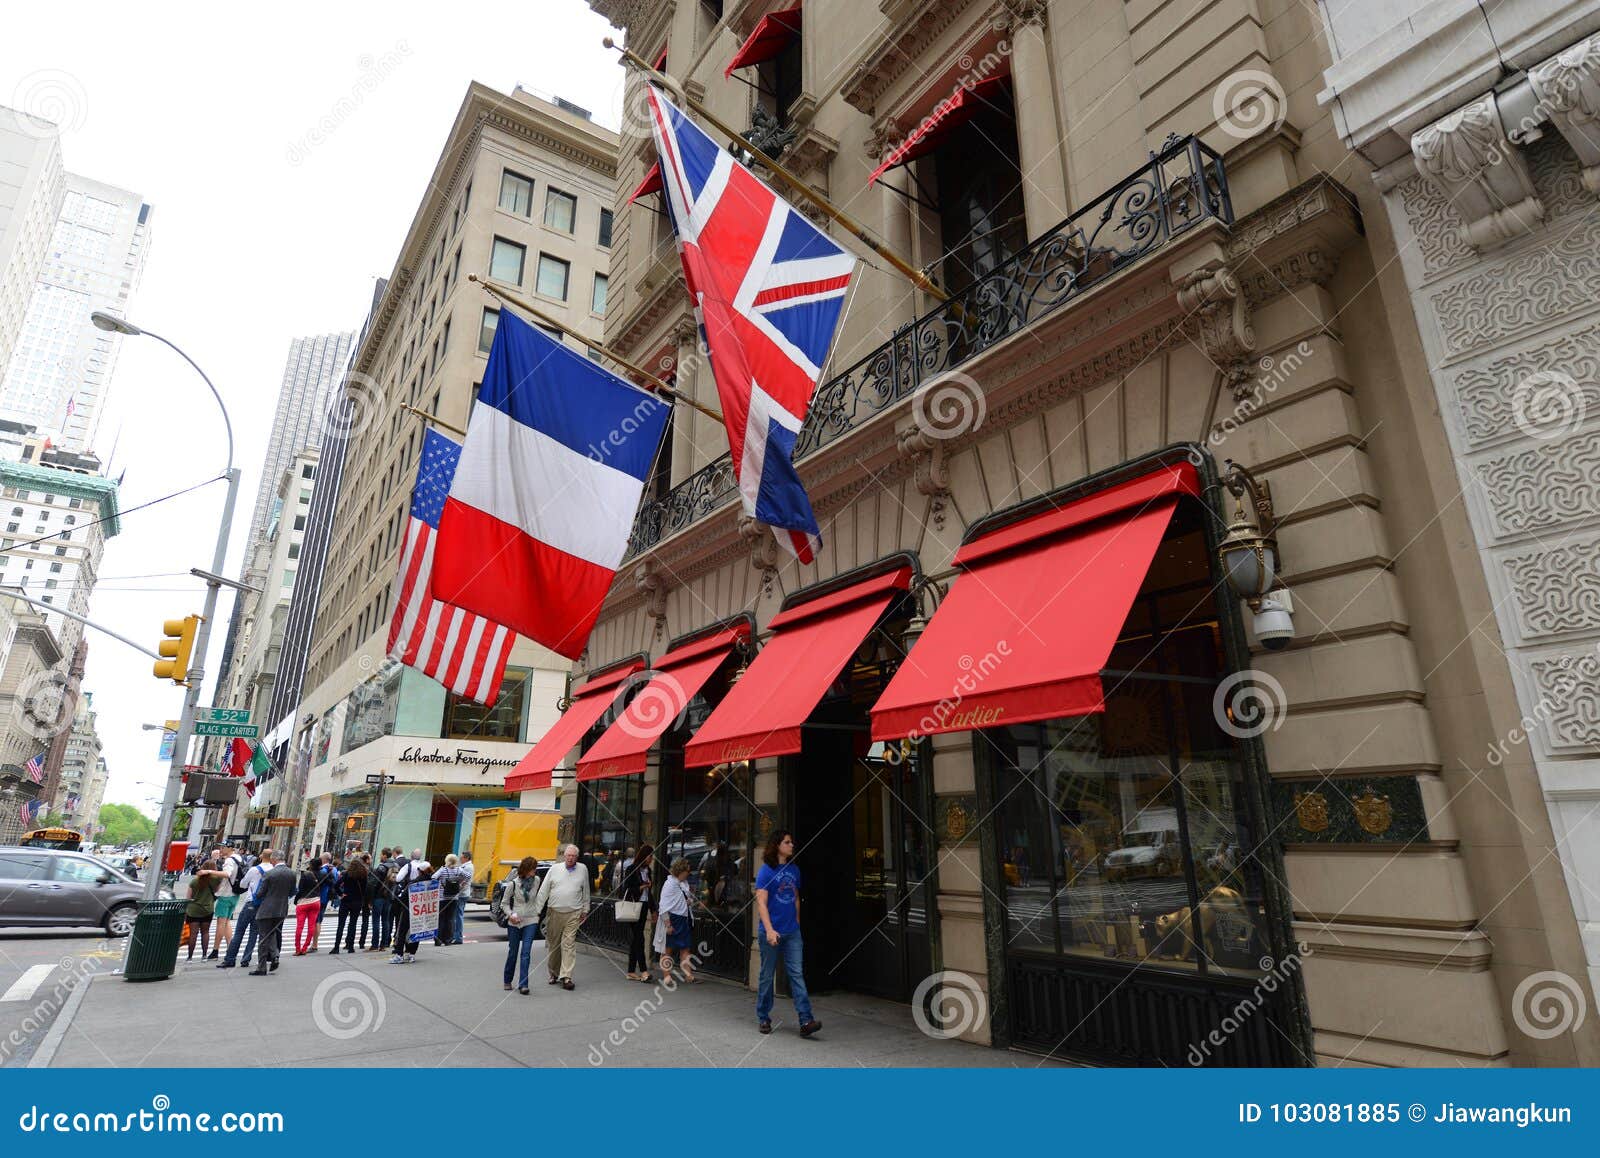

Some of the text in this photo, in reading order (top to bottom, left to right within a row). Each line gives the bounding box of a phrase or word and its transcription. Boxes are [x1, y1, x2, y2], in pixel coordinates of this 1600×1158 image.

[210, 709, 217, 720] E
[220, 710, 239, 721] 52
[941, 707, 1004, 730] Cartier
[198, 724, 220, 735] PLACE
[229, 725, 256, 736] CARTIER
[398, 746, 520, 775] Salvatore Ferragamo
[412, 901, 437, 916] SALE
